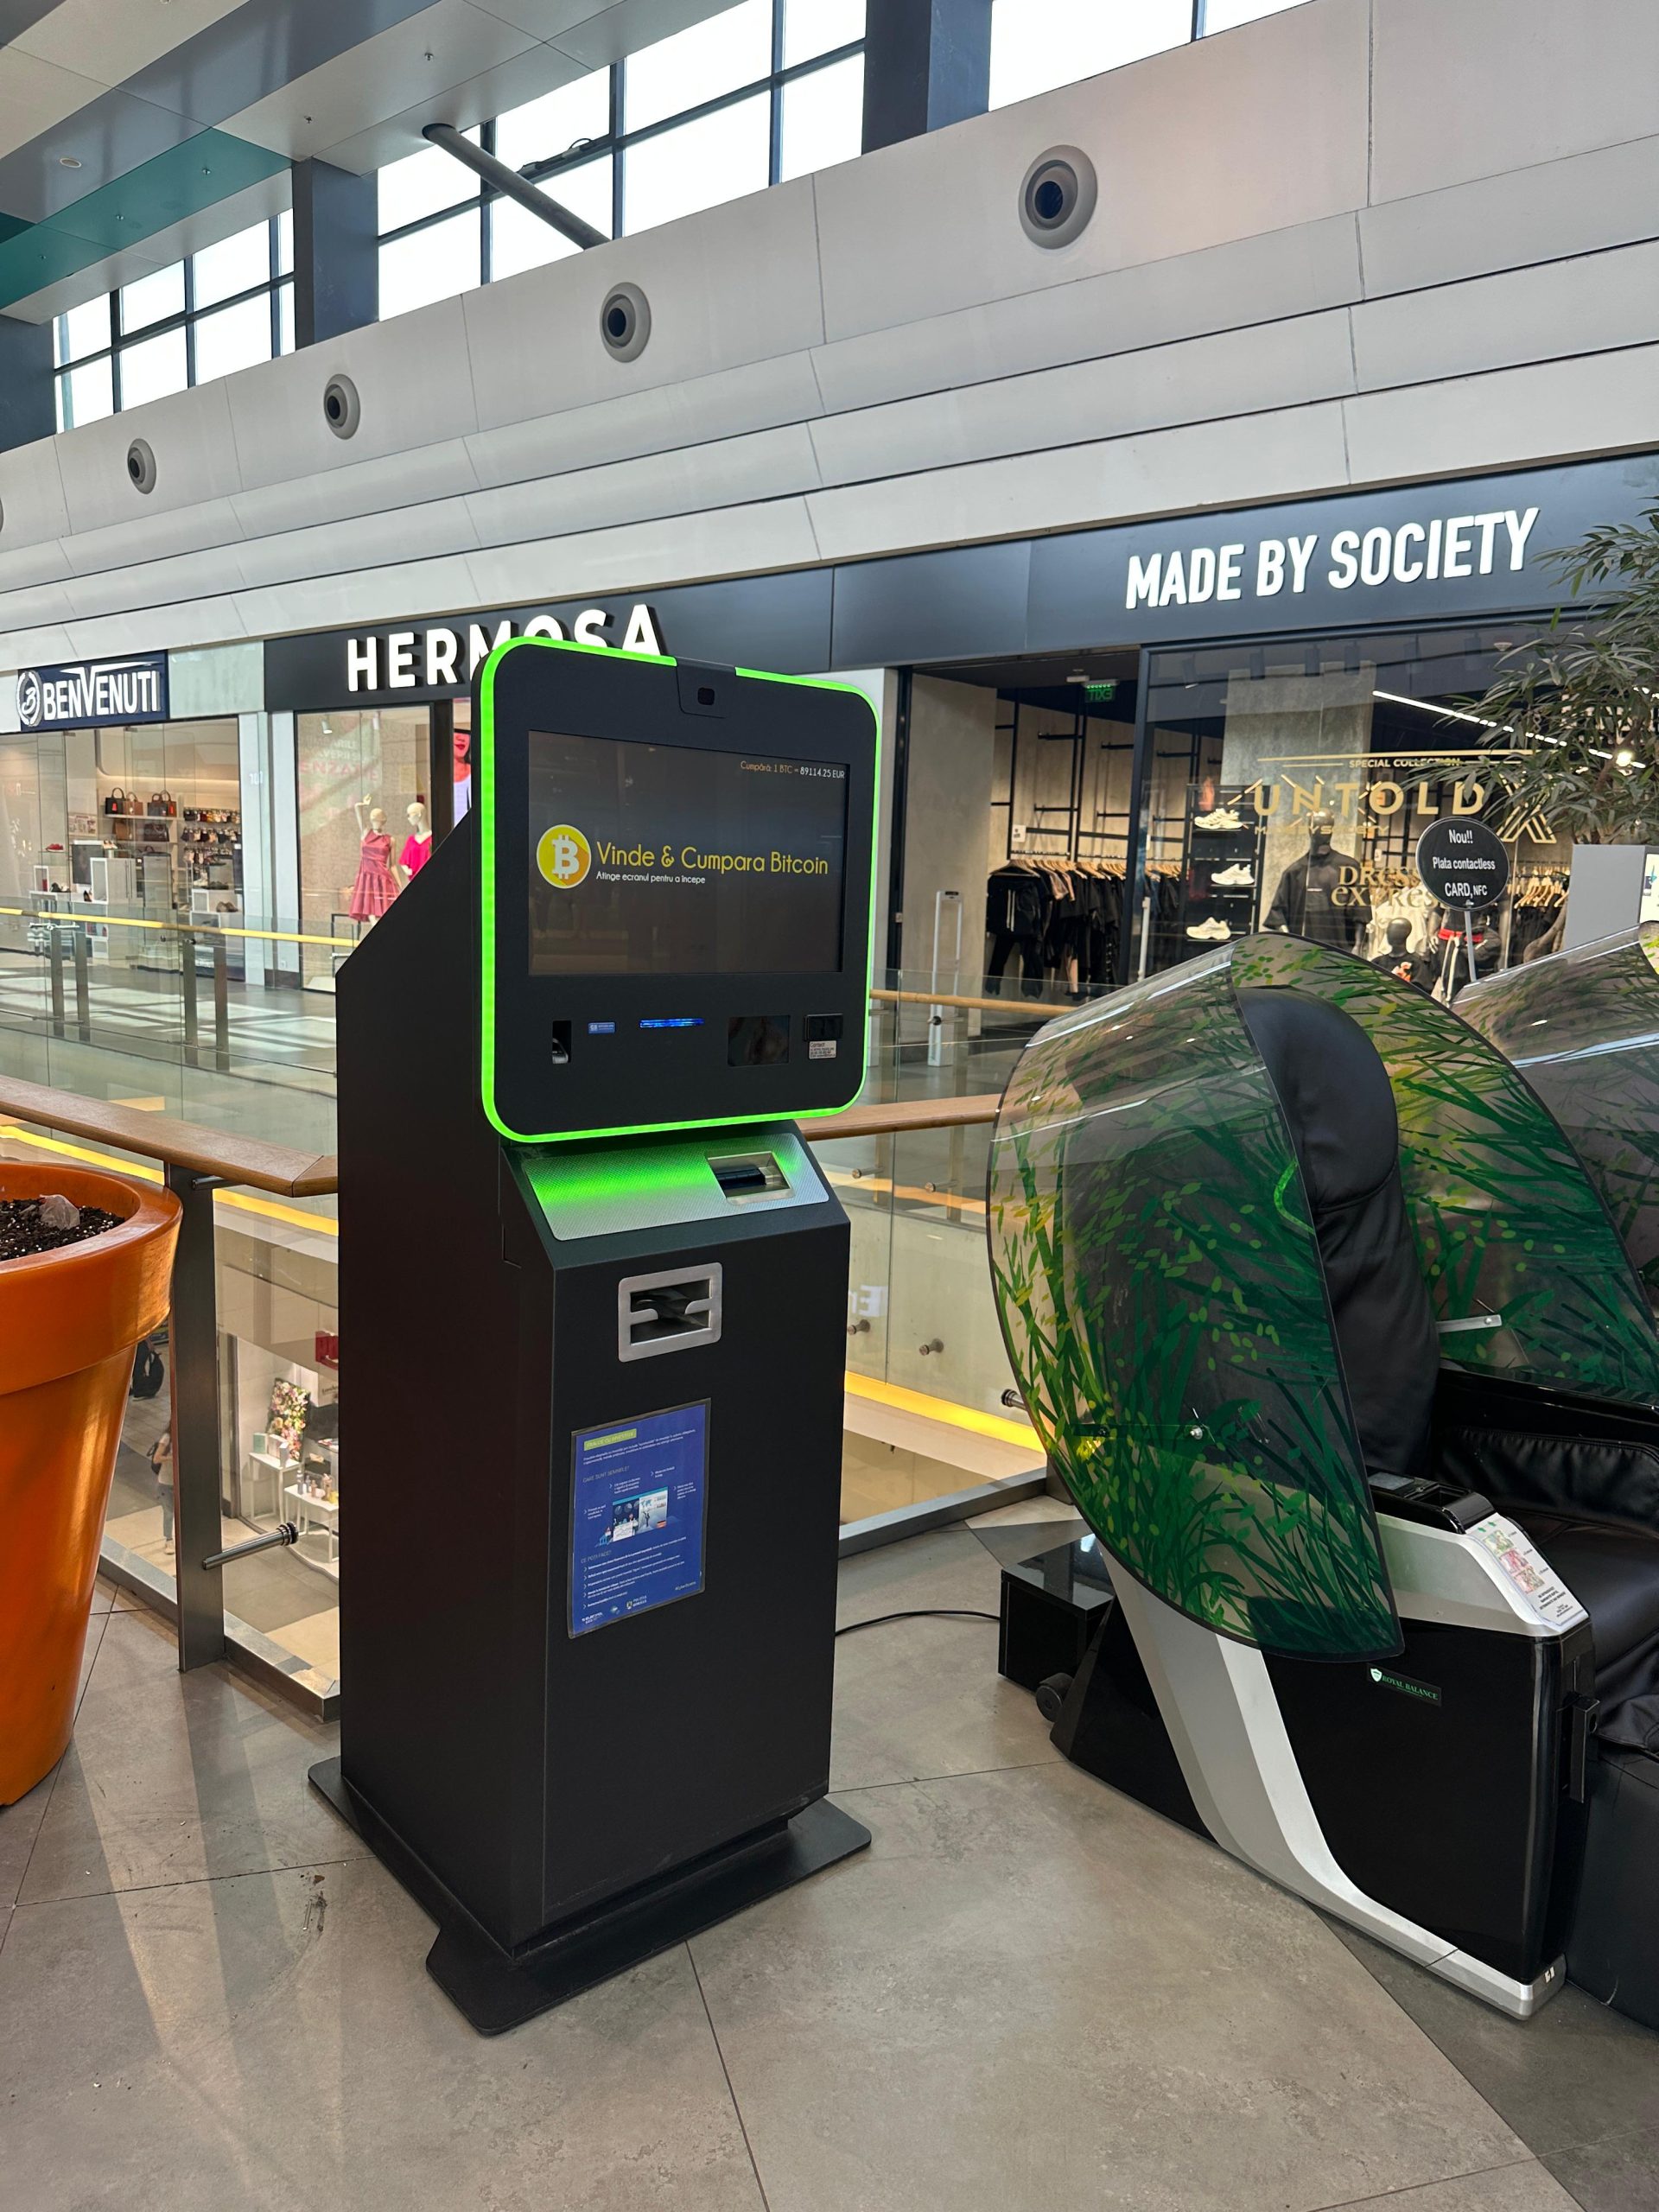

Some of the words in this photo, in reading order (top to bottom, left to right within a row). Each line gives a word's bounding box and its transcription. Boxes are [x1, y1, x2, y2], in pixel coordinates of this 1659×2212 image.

[1126, 543, 1245, 609] MADE
[1256, 534, 1319, 596] BY
[1328, 506, 1541, 588] SOCIETY
[43, 661, 162, 721] BENVENUTI
[779, 764, 793, 774] BTC
[800, 766, 831, 778] 89114.25
[832, 769, 845, 779] EUR
[1349, 759, 1391, 768] SPECIAL
[1254, 781, 1485, 817] UNTOLD
[1448, 829, 1473, 844] Nou!!
[597, 841, 655, 867] Vinde
[661, 845, 675, 868] &
[681, 846, 766, 874] Cumpara
[771, 851, 829, 874] Bitcoin
[1433, 856, 1452, 869] Plata
[1452, 857, 1496, 870] contactless
[596, 870, 620, 881] Atinge
[622, 873, 649, 881] ecranul
[651, 874, 673, 883] pentru
[1445, 882, 1473, 899] CARD,
[1473, 884, 1488, 896] NFC
[1382, 1675, 1405, 1688] ROYAL
[1405, 1683, 1439, 1700] BALANCE
